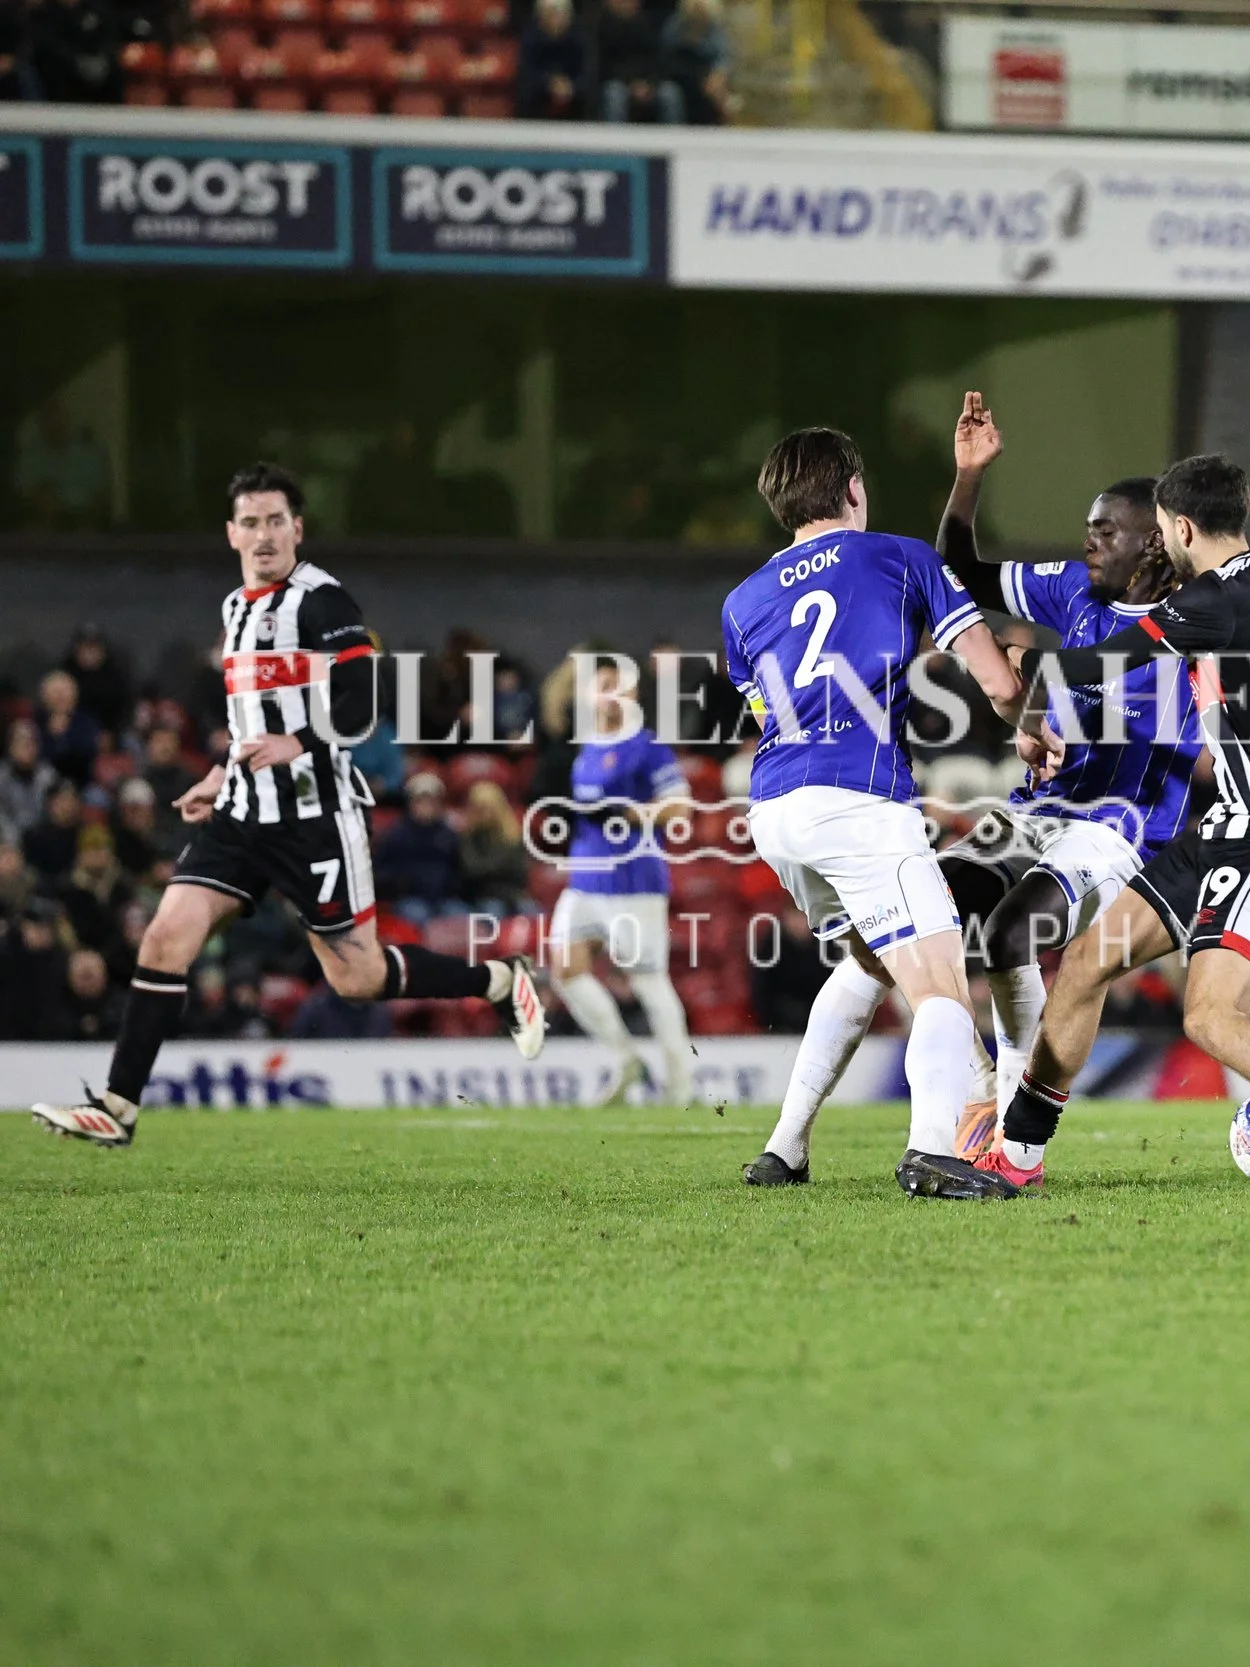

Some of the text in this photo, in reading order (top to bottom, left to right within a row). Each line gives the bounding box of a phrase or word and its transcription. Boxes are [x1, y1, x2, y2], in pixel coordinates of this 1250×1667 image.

[98, 155, 319, 218] ROOST
[401, 166, 618, 226] ROOST
[706, 183, 1048, 241] HANDTRANS
[779, 545, 841, 587] COOK
[790, 589, 837, 689] 2
[311, 858, 341, 903] 7
[1197, 866, 1241, 913] 19
